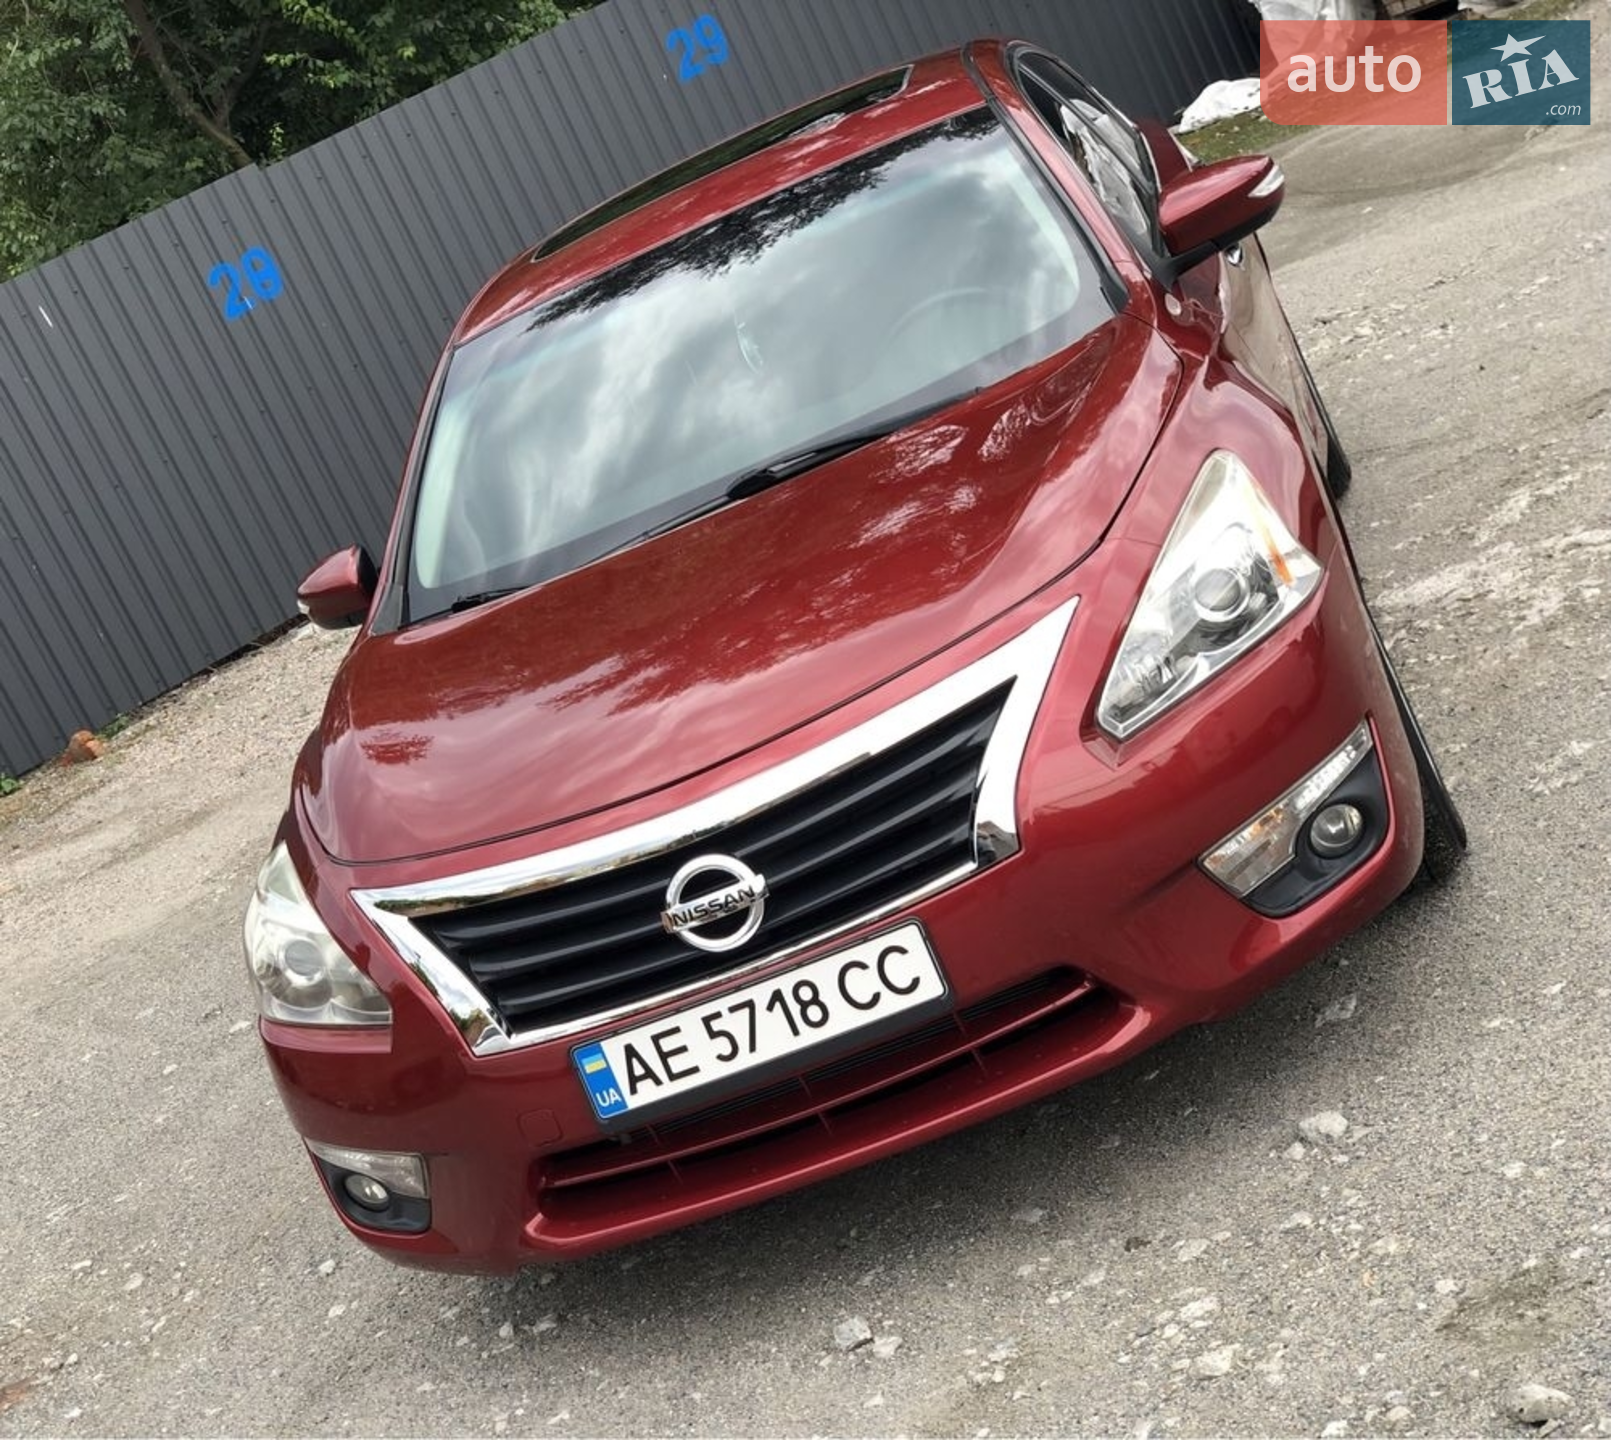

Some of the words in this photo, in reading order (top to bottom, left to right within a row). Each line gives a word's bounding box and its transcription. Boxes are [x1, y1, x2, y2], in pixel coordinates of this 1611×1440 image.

[665, 13, 729, 82] 29
[671, 884, 757, 926] NISSAN
[623, 1026, 700, 1096] AE
[701, 980, 830, 1062] 5718
[837, 945, 921, 1011] CC
[595, 1087, 621, 1108] UA
